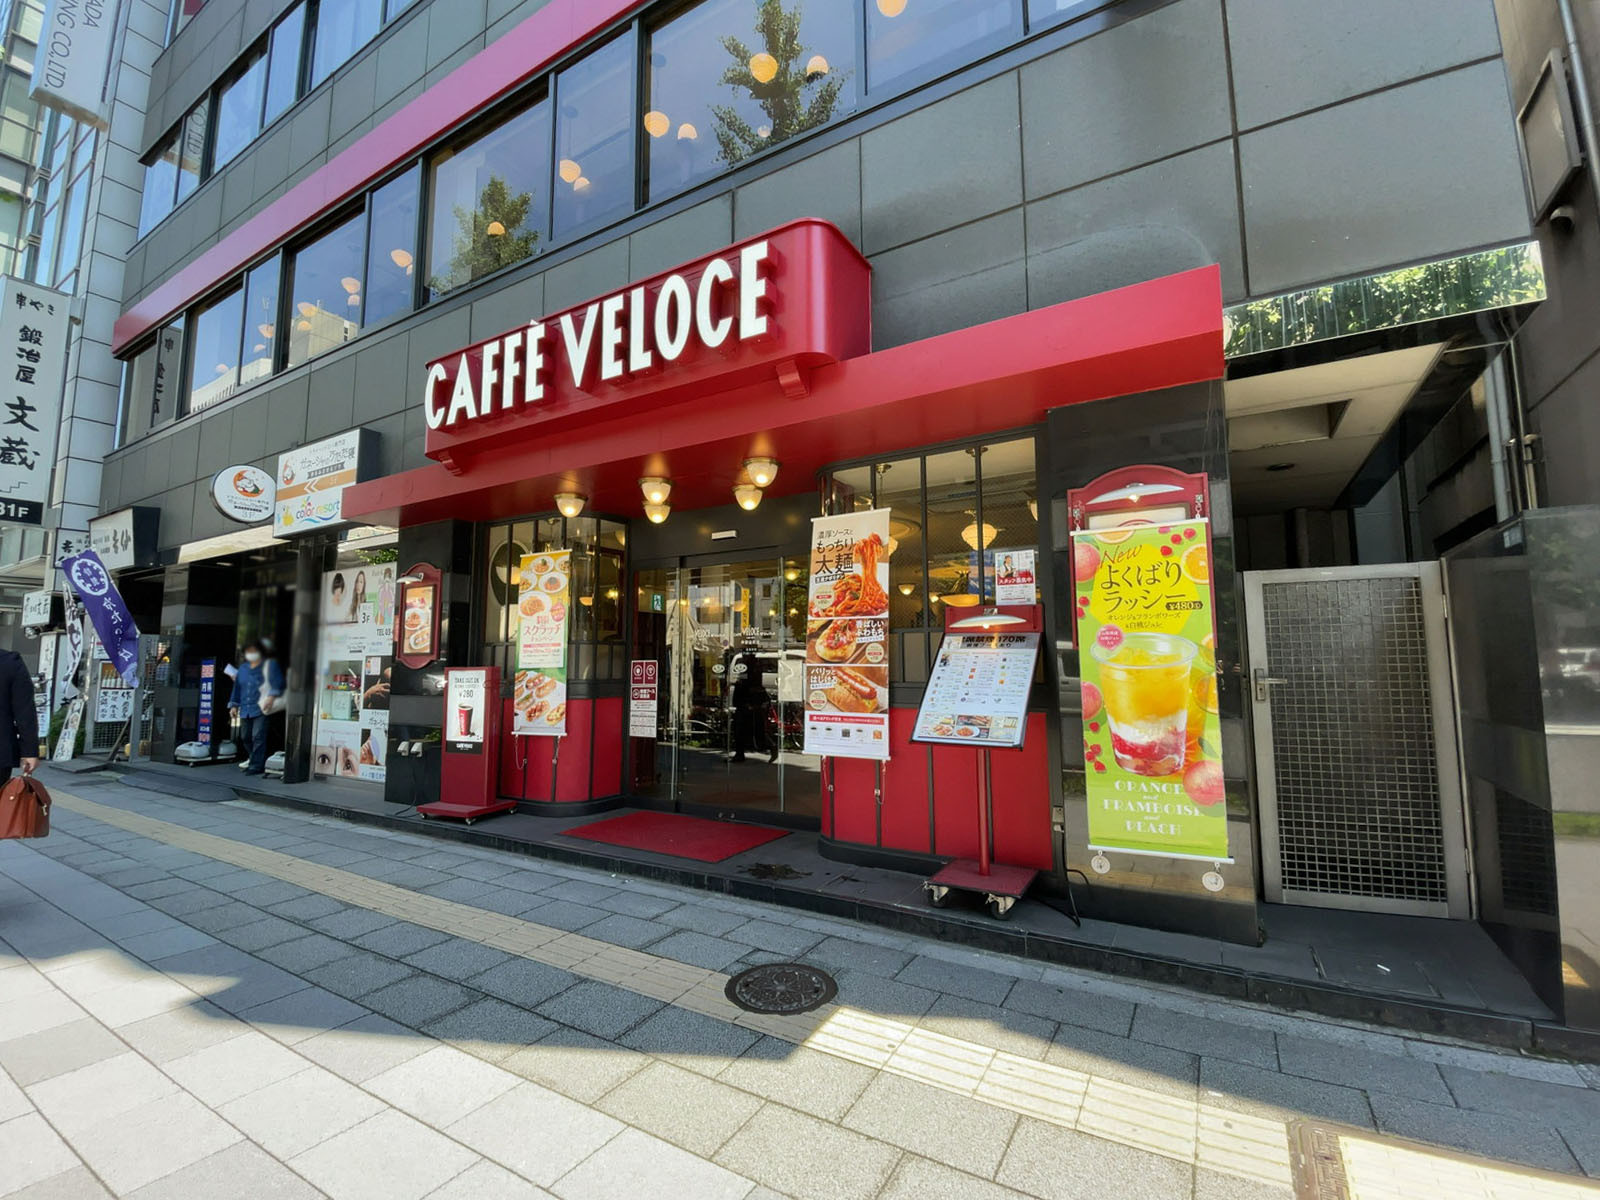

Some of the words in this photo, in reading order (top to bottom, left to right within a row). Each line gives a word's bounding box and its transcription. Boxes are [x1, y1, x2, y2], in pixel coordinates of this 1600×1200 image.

[16, 291, 55, 316] 串やき
[425, 319, 546, 430] CAFFÈ
[560, 240, 769, 388] VELOCE
[296, 505, 315, 519] color
[816, 537, 853, 554] もっちり
[1100, 544, 1142, 568] New
[815, 553, 854, 575] 太麺
[1100, 560, 1182, 590] よくばり
[1103, 588, 1187, 614] ラッシー
[524, 624, 561, 636] スクラッチ
[1126, 820, 1183, 835] PEACH
